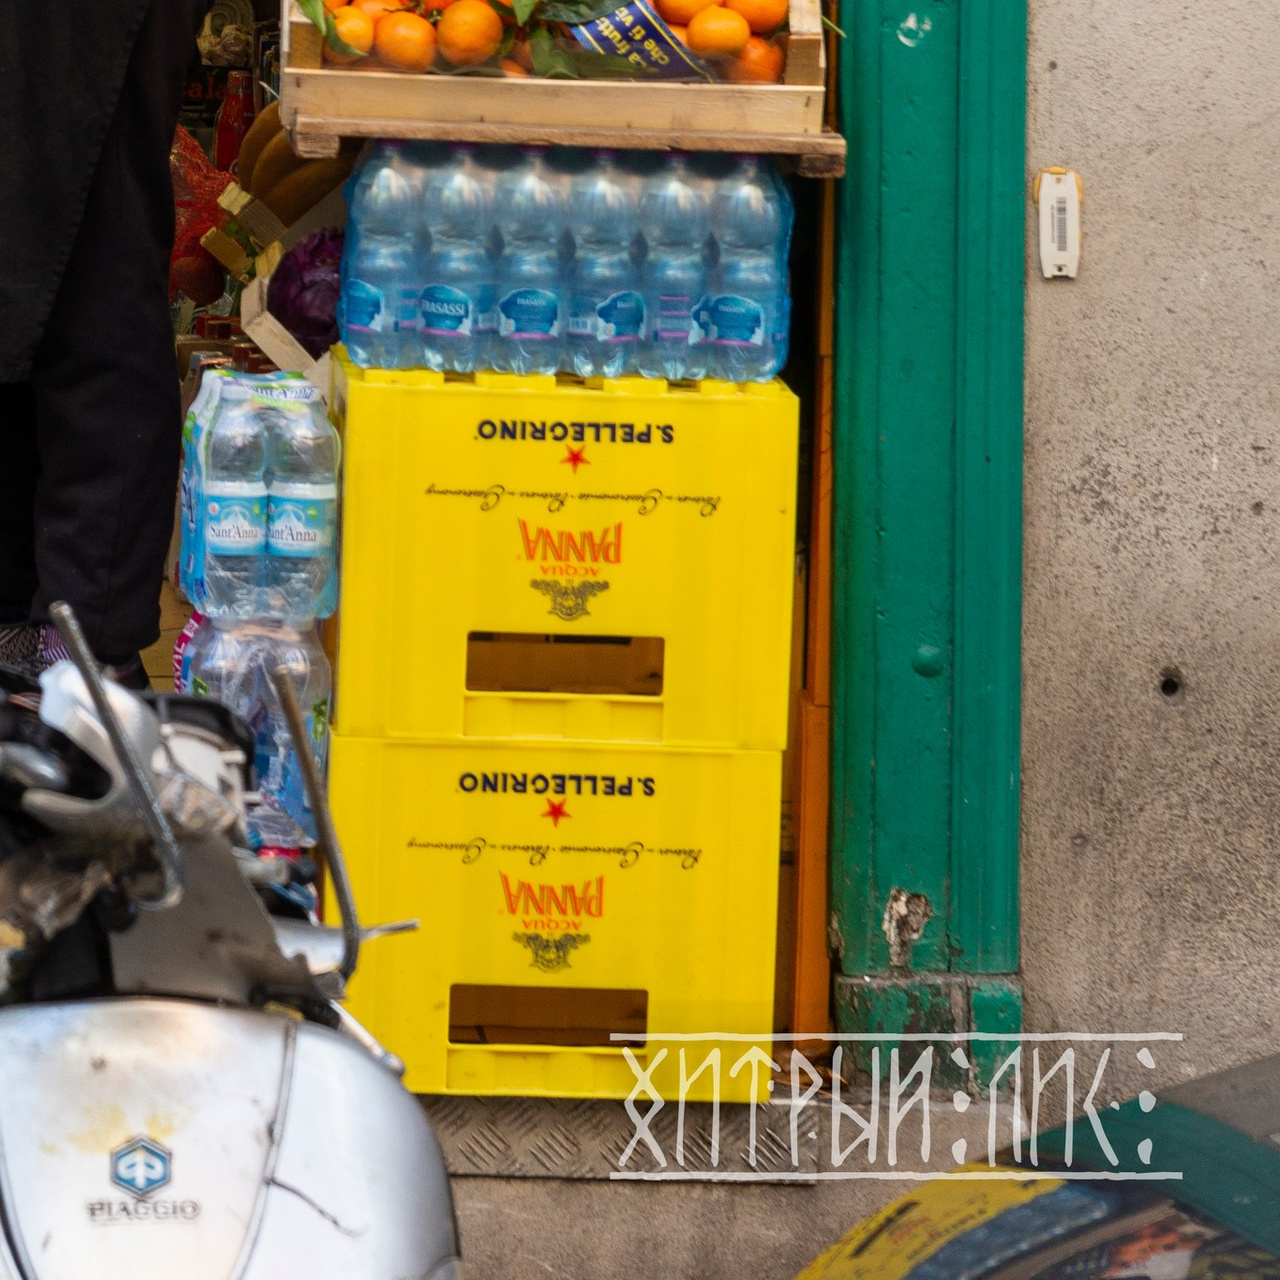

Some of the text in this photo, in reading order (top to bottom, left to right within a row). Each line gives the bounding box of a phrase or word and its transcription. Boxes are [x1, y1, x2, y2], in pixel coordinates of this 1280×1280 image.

[477, 419, 675, 444] S.PELLEGRINO
[209, 522, 258, 539] Sant'Anna
[518, 520, 623, 564] PANNA
[540, 565, 601, 578] ACQUA
[459, 772, 656, 796] S.PELLEGRINO
[499, 872, 605, 917] PANNA
[521, 918, 582, 932] ACQUA
[88, 1198, 201, 1221] PIAGGIO
